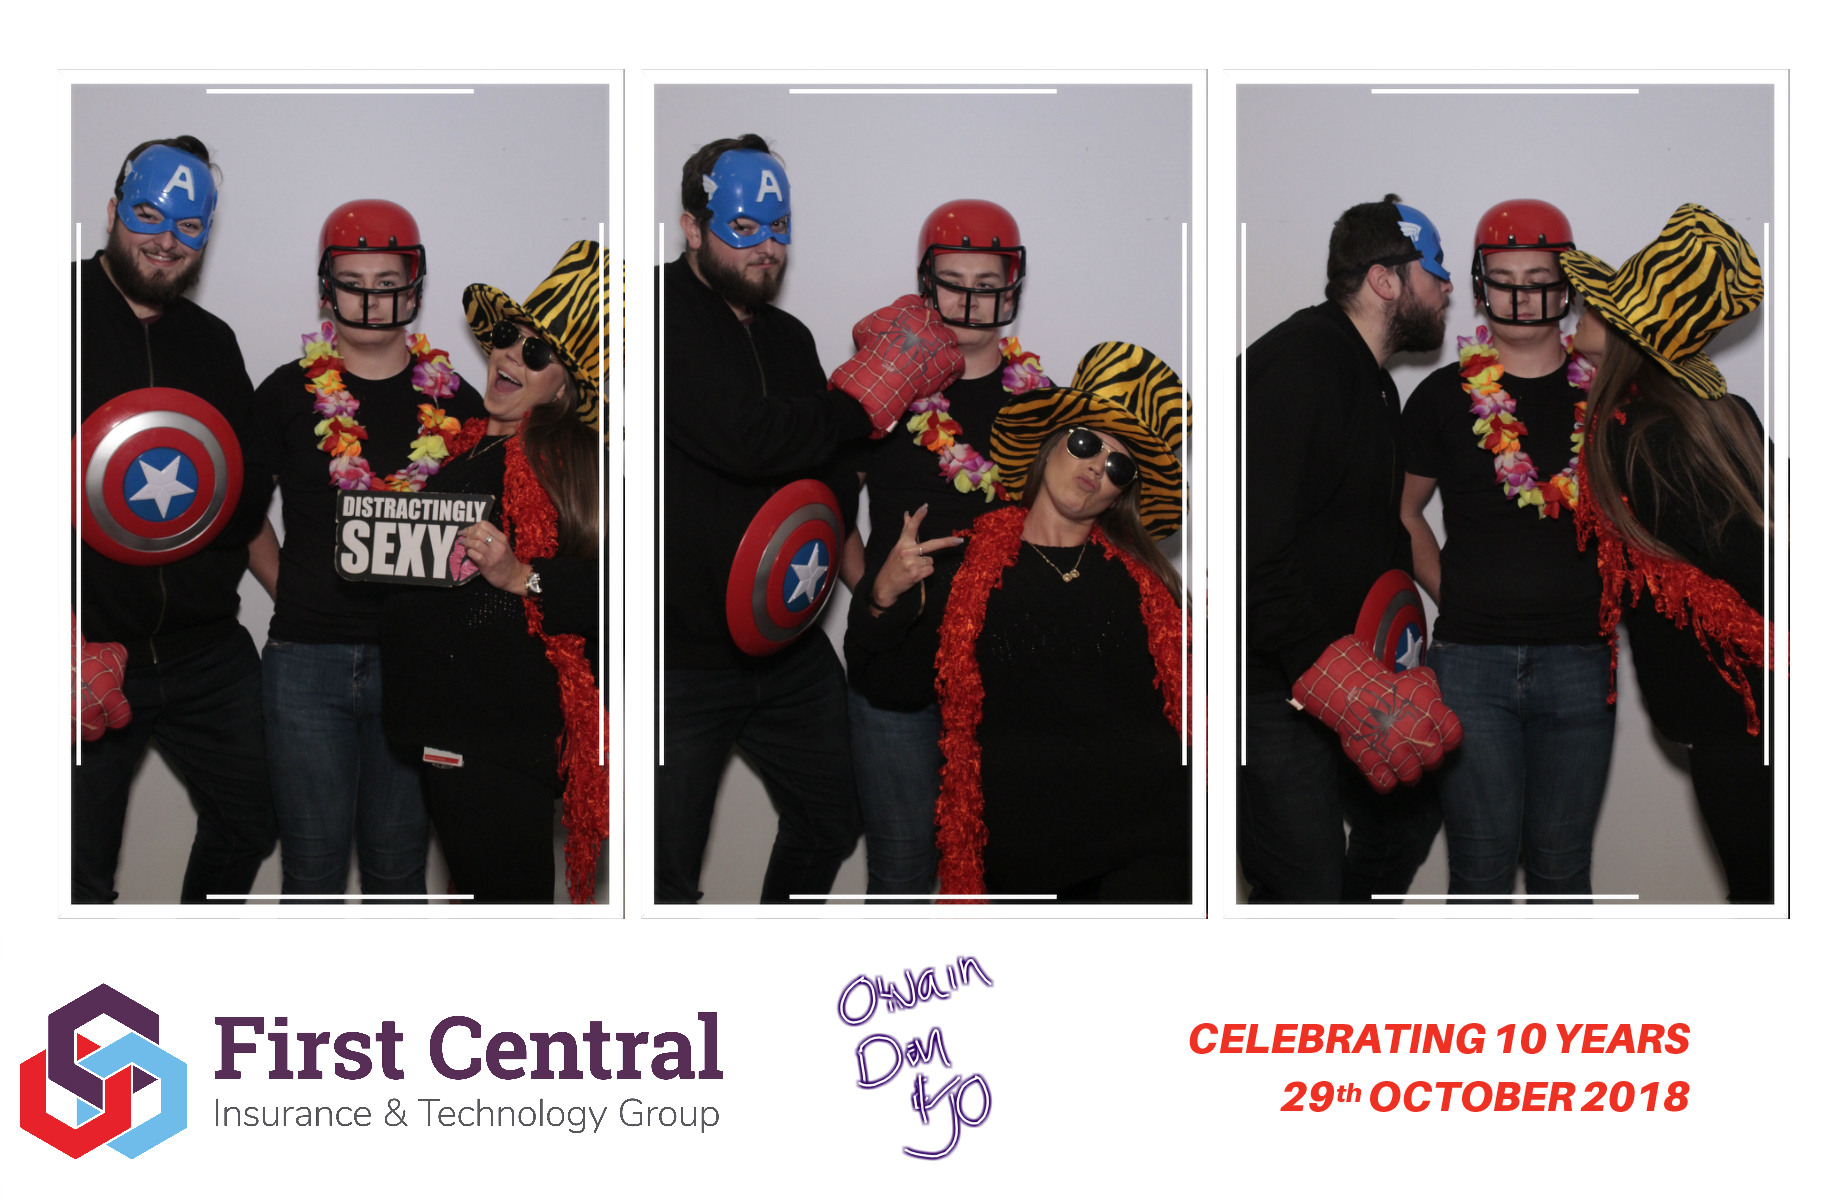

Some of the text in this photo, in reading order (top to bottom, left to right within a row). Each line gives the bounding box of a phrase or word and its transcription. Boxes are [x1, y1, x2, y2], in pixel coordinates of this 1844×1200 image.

[163, 164, 195, 202] A
[756, 169, 783, 203] A
[342, 496, 487, 523] DISTRACTINGLY
[340, 519, 459, 579] SEXY
